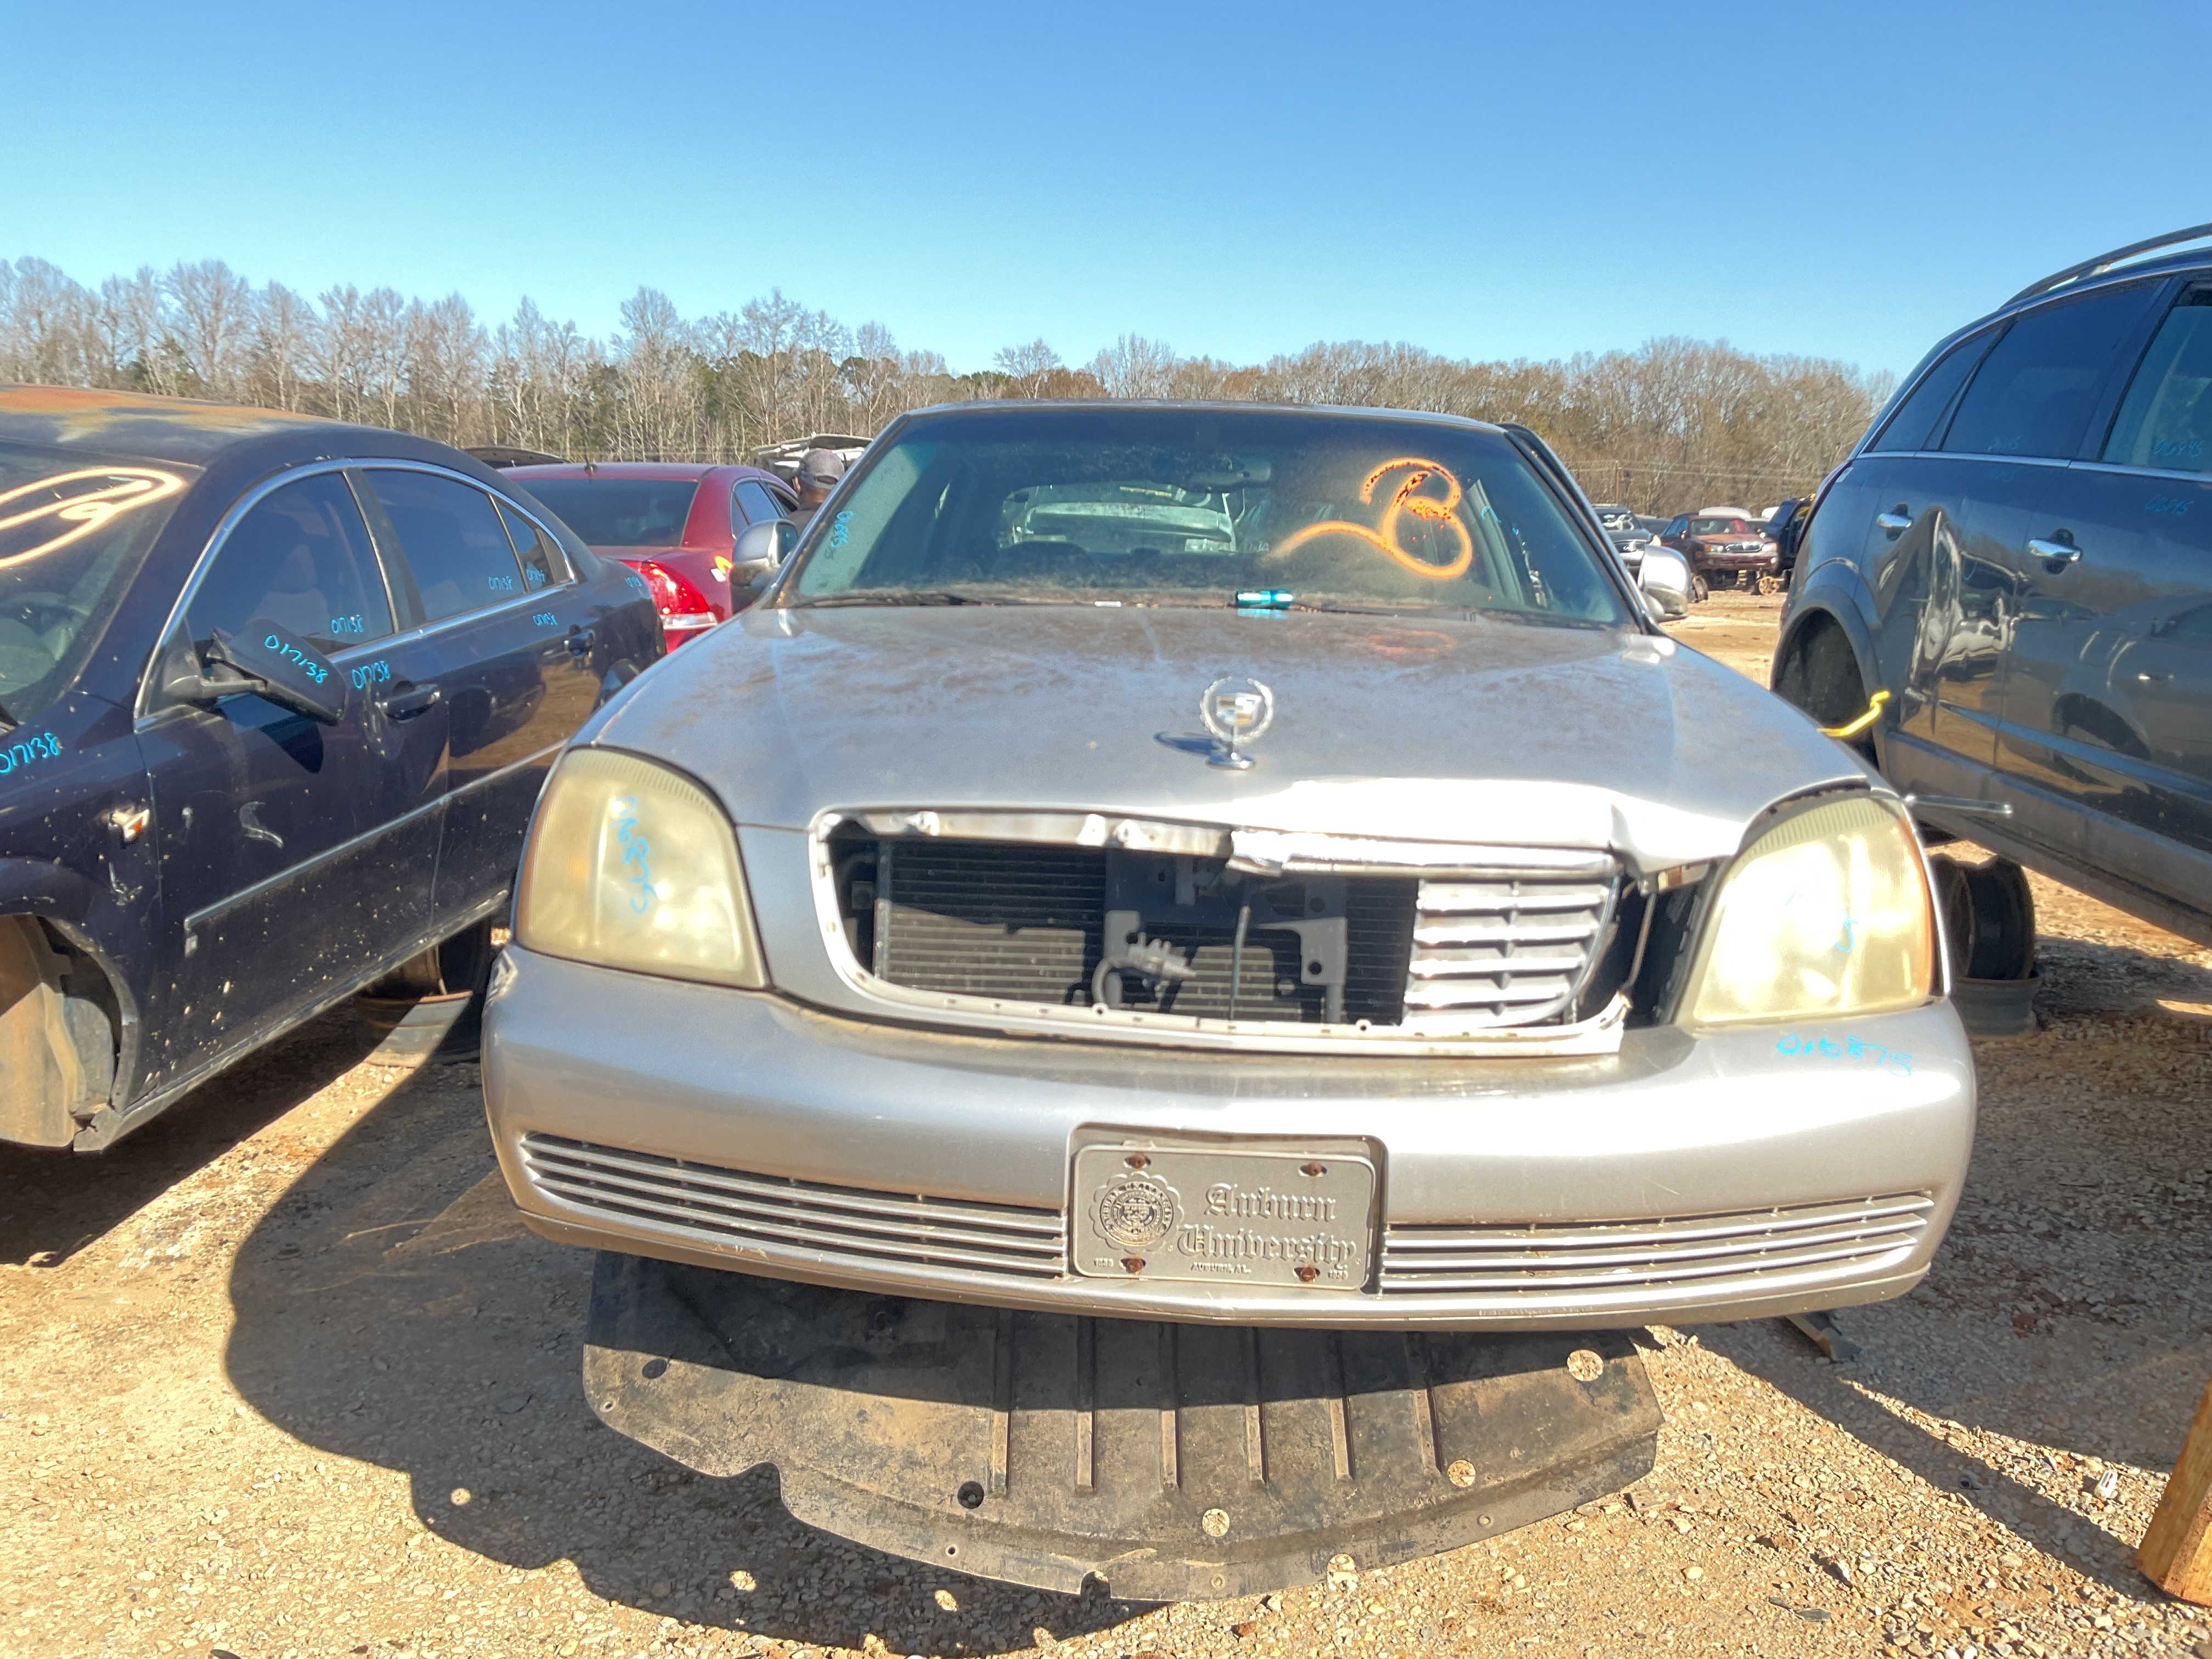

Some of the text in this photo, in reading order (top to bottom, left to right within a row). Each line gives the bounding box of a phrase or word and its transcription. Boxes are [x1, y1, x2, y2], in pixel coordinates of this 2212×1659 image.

[264, 634, 329, 684] 017138
[351, 659, 391, 690] 017138
[1204, 1182, 1336, 1223] Auburn
[1176, 1223, 1357, 1270] University
[1234, 1263, 1251, 1274] AL.
